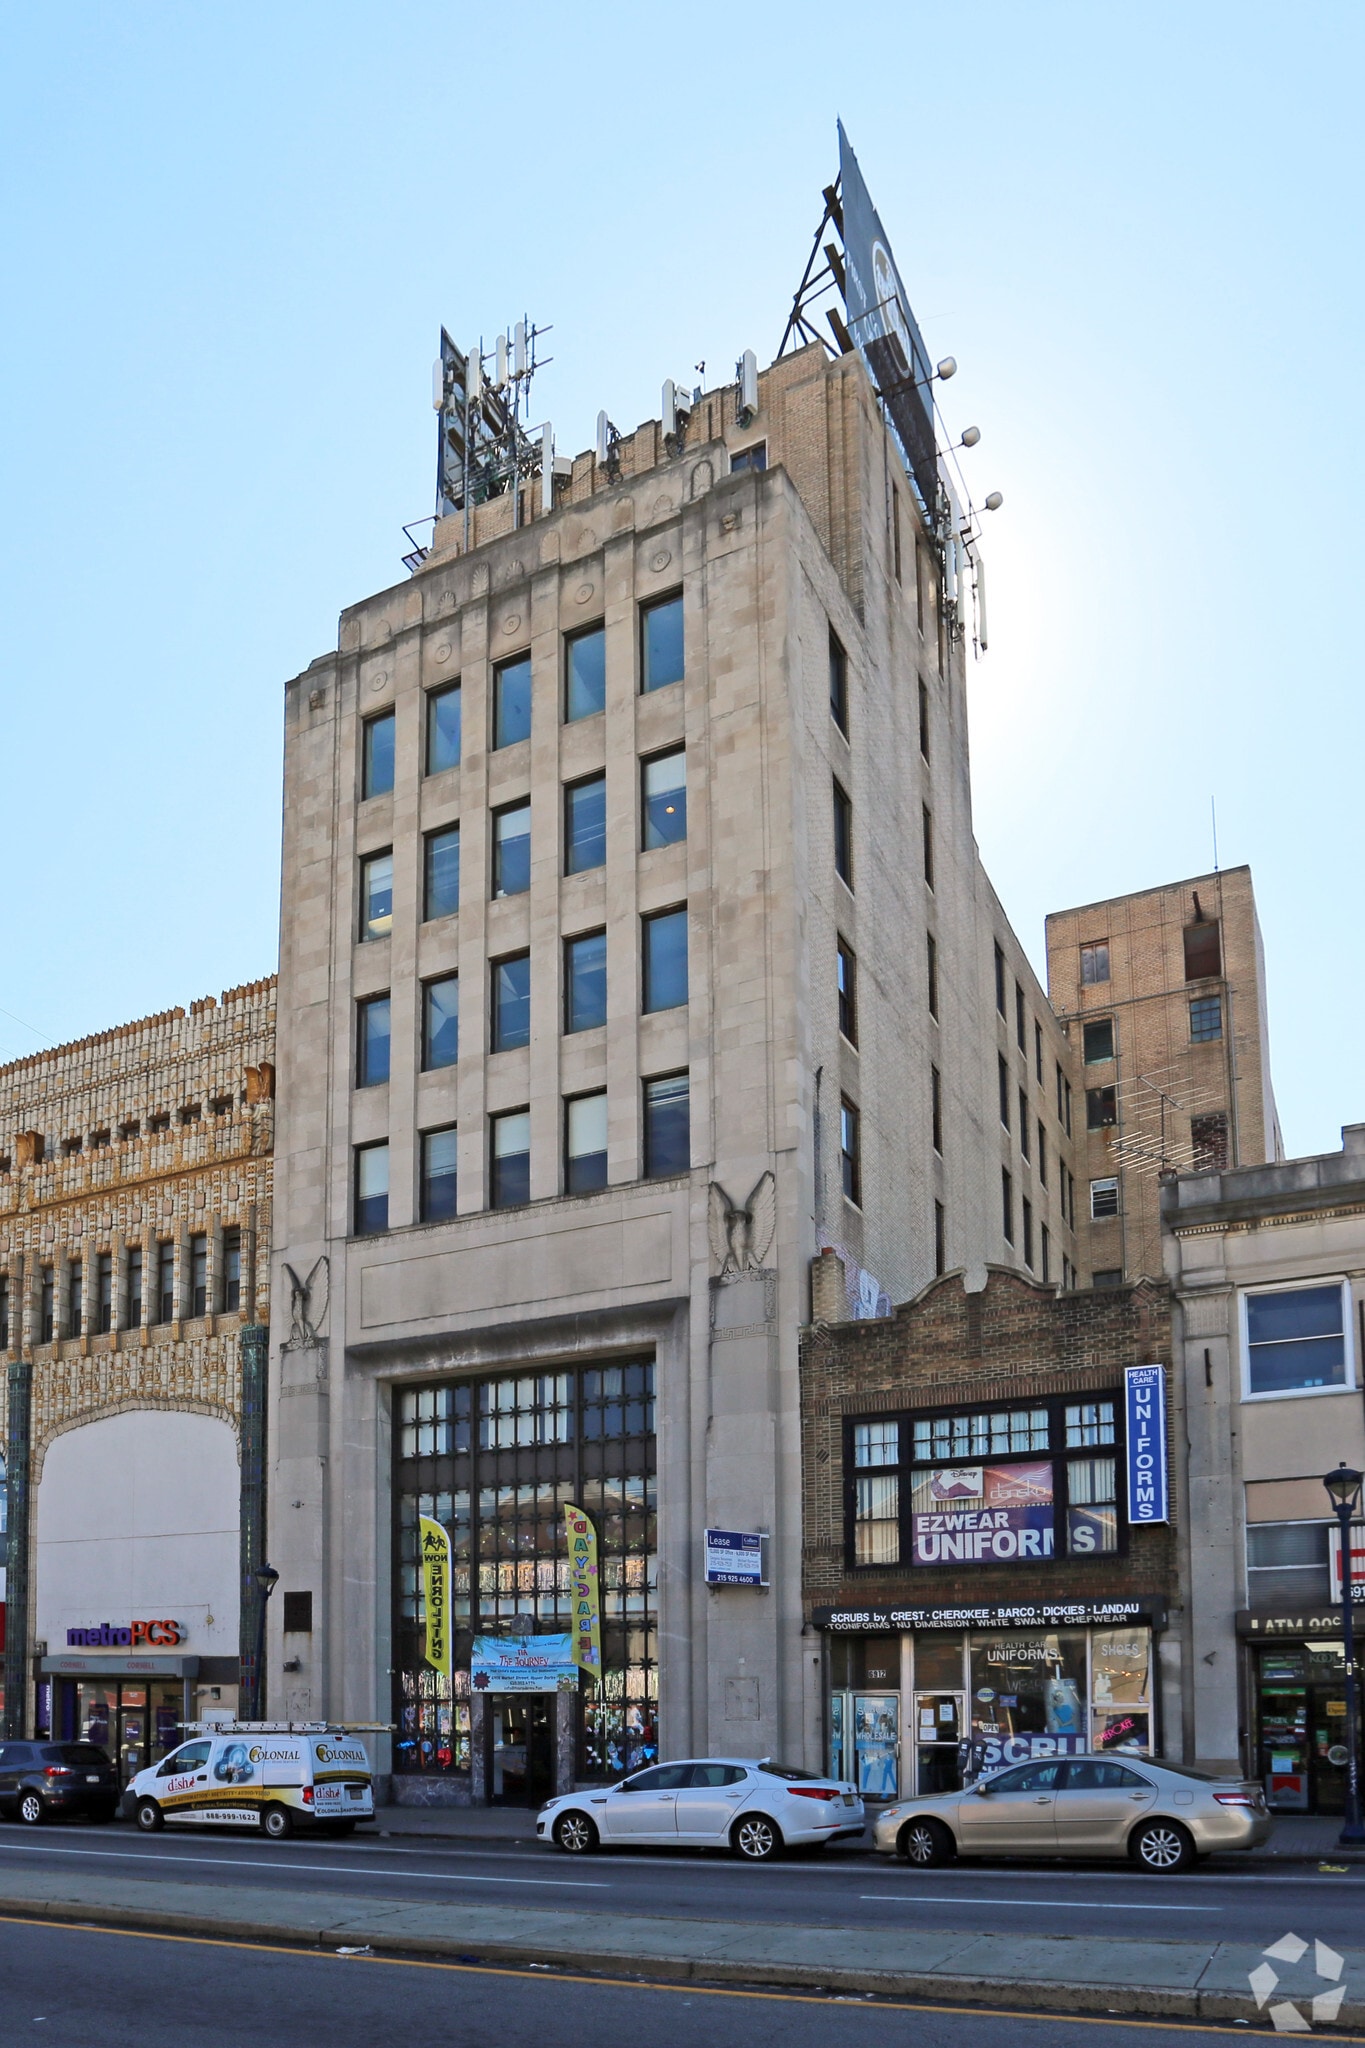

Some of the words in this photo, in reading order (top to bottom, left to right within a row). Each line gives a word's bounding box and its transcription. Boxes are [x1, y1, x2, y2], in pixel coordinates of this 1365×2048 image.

[1128, 1369, 1158, 1379] HEALTH
[1133, 1376, 1154, 1385] CARE
[1136, 1388, 1154, 1518] UNIFORMS
[990, 1479, 1046, 1499] dansko
[917, 1512, 1009, 1532] EZWEAR
[710, 1535, 731, 1546] Lease
[717, 1574, 727, 1582] 215
[739, 1576, 754, 1584] 4600
[831, 1613, 870, 1623] SCRUBS
[873, 1612, 887, 1623] by
[890, 1611, 925, 1621] CREST
[931, 1609, 990, 1620] CHEROKEE
[998, 1607, 1035, 1618] BARCO
[1043, 1605, 1085, 1616] DICKIES
[1093, 1603, 1140, 1614] LANDAU
[827, 1621, 891, 1630] TOONIFORMS
[896, 1621, 911, 1629] NU
[915, 1619, 970, 1628] DIMENSION
[976, 1618, 1010, 1627] WHITE
[1014, 1617, 1046, 1626] SWAN
[1050, 1616, 1059, 1625] &
[1064, 1614, 1128, 1624] CHEFWEAR
[1265, 1618, 1303, 1634] ATM
[67, 1619, 180, 1646] metroPCS
[994, 1641, 1025, 1650] HEALTH
[1101, 1643, 1139, 1657] SHOES
[987, 1648, 1058, 1662] UNIFORMS
[1309, 1653, 1339, 1664] KOOL
[856, 1731, 896, 1741] WHOLESALE
[1093, 1717, 1135, 1745] CHEROKEE
[249, 1745, 300, 1763] COLONIAL
[316, 1744, 365, 1763] COLONIAL
[167, 1776, 190, 1792] dish
[316, 1787, 335, 1799] dish
[205, 1812, 256, 1821] 888-999-1622
